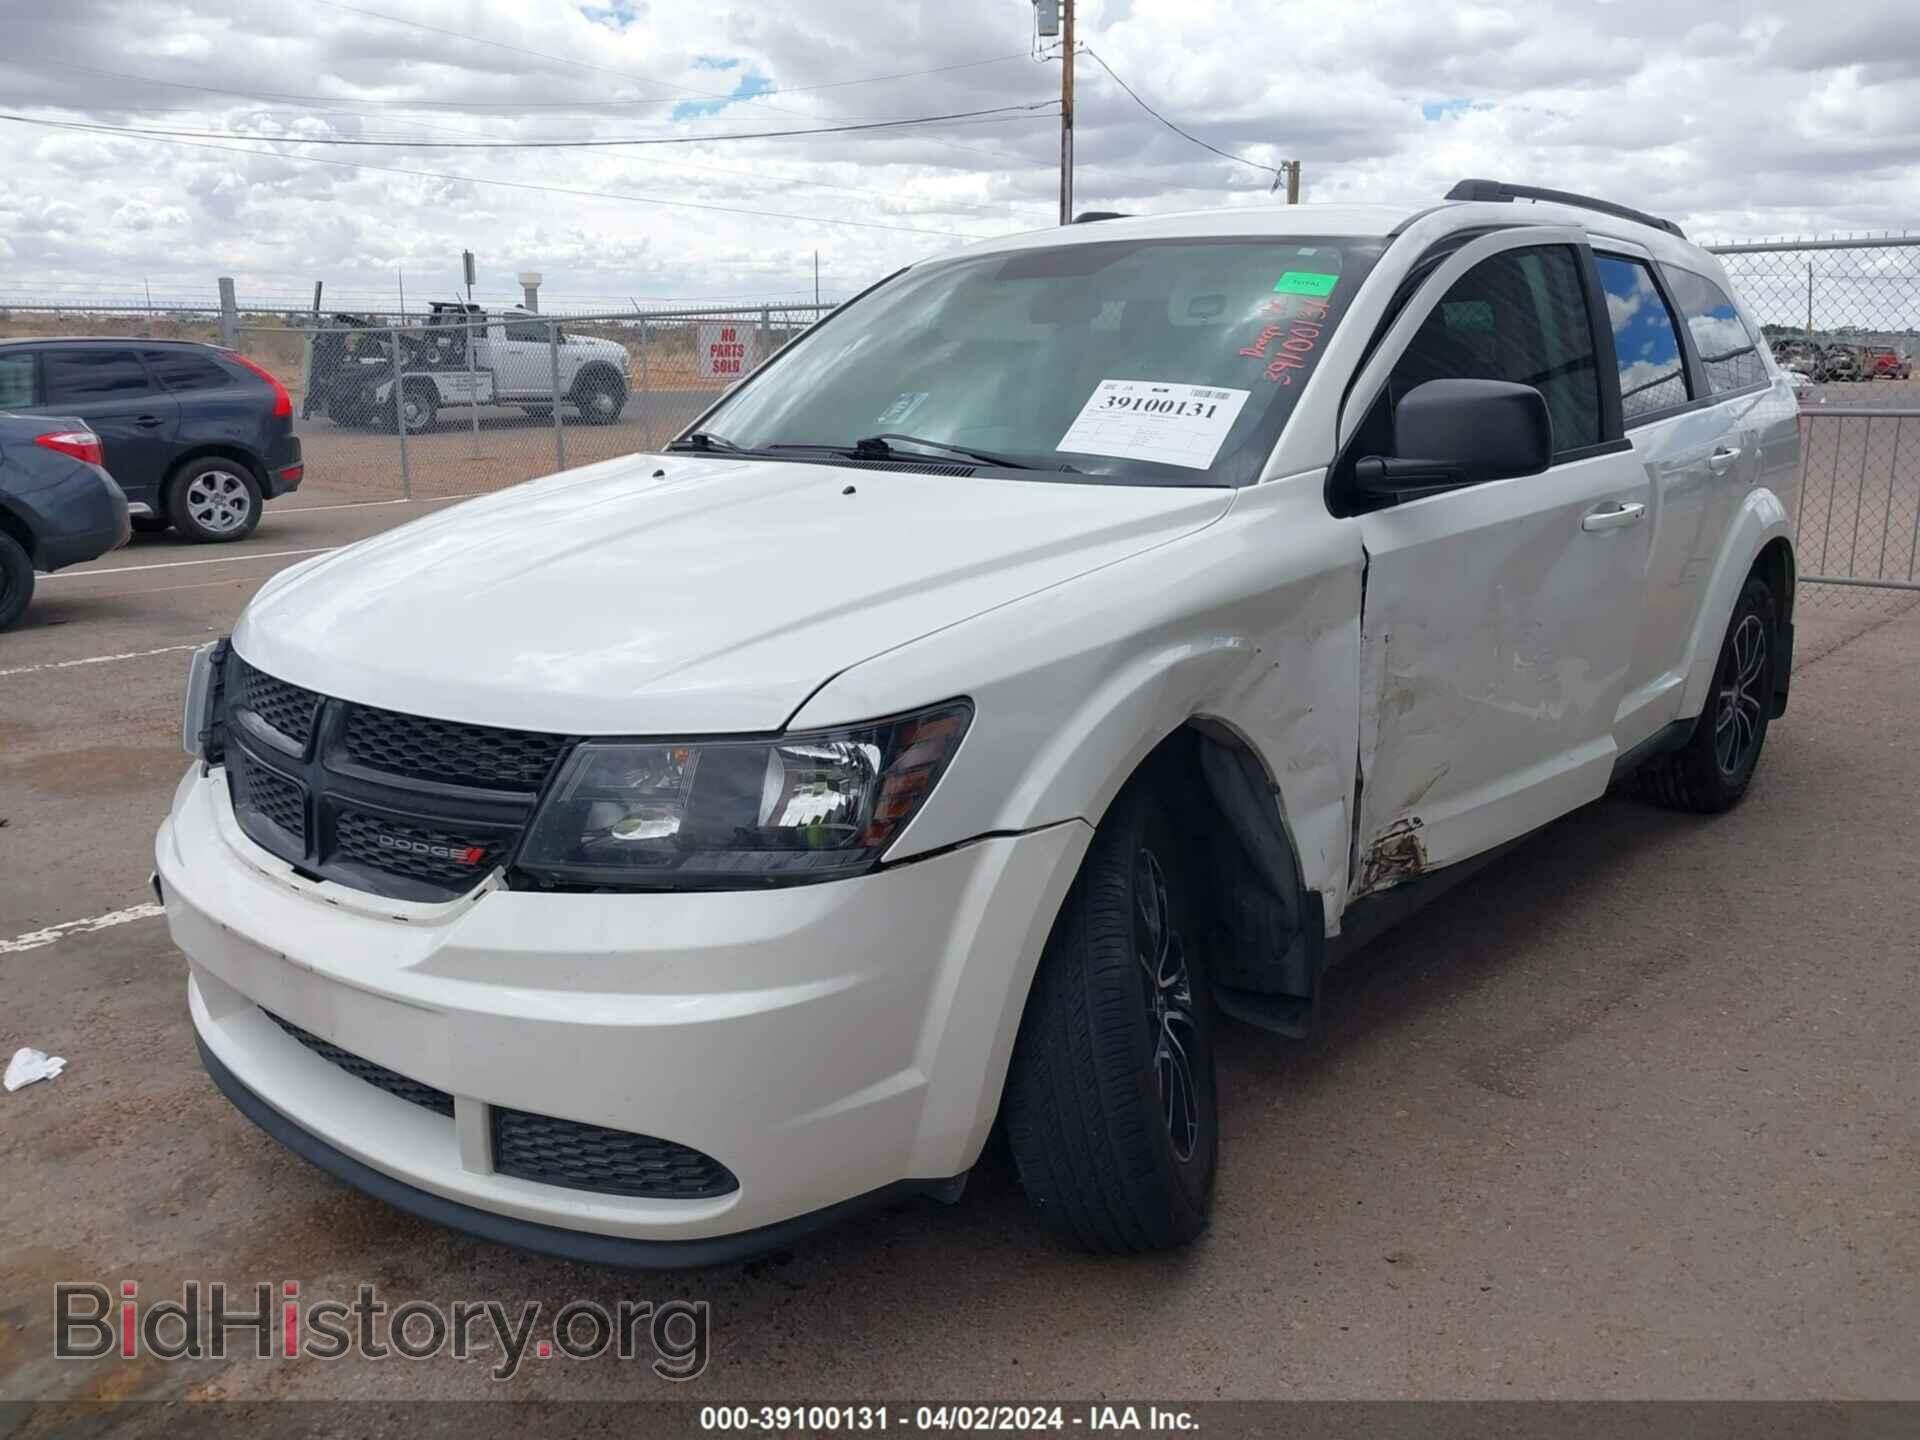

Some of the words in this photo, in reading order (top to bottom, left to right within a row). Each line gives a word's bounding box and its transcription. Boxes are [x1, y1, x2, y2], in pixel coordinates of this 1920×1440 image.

[721, 328, 737, 342] NO
[710, 344, 745, 358] PARTS
[712, 359, 740, 373] SOLD
[1100, 395, 1217, 419] 39100131
[379, 835, 468, 860] DODGE
